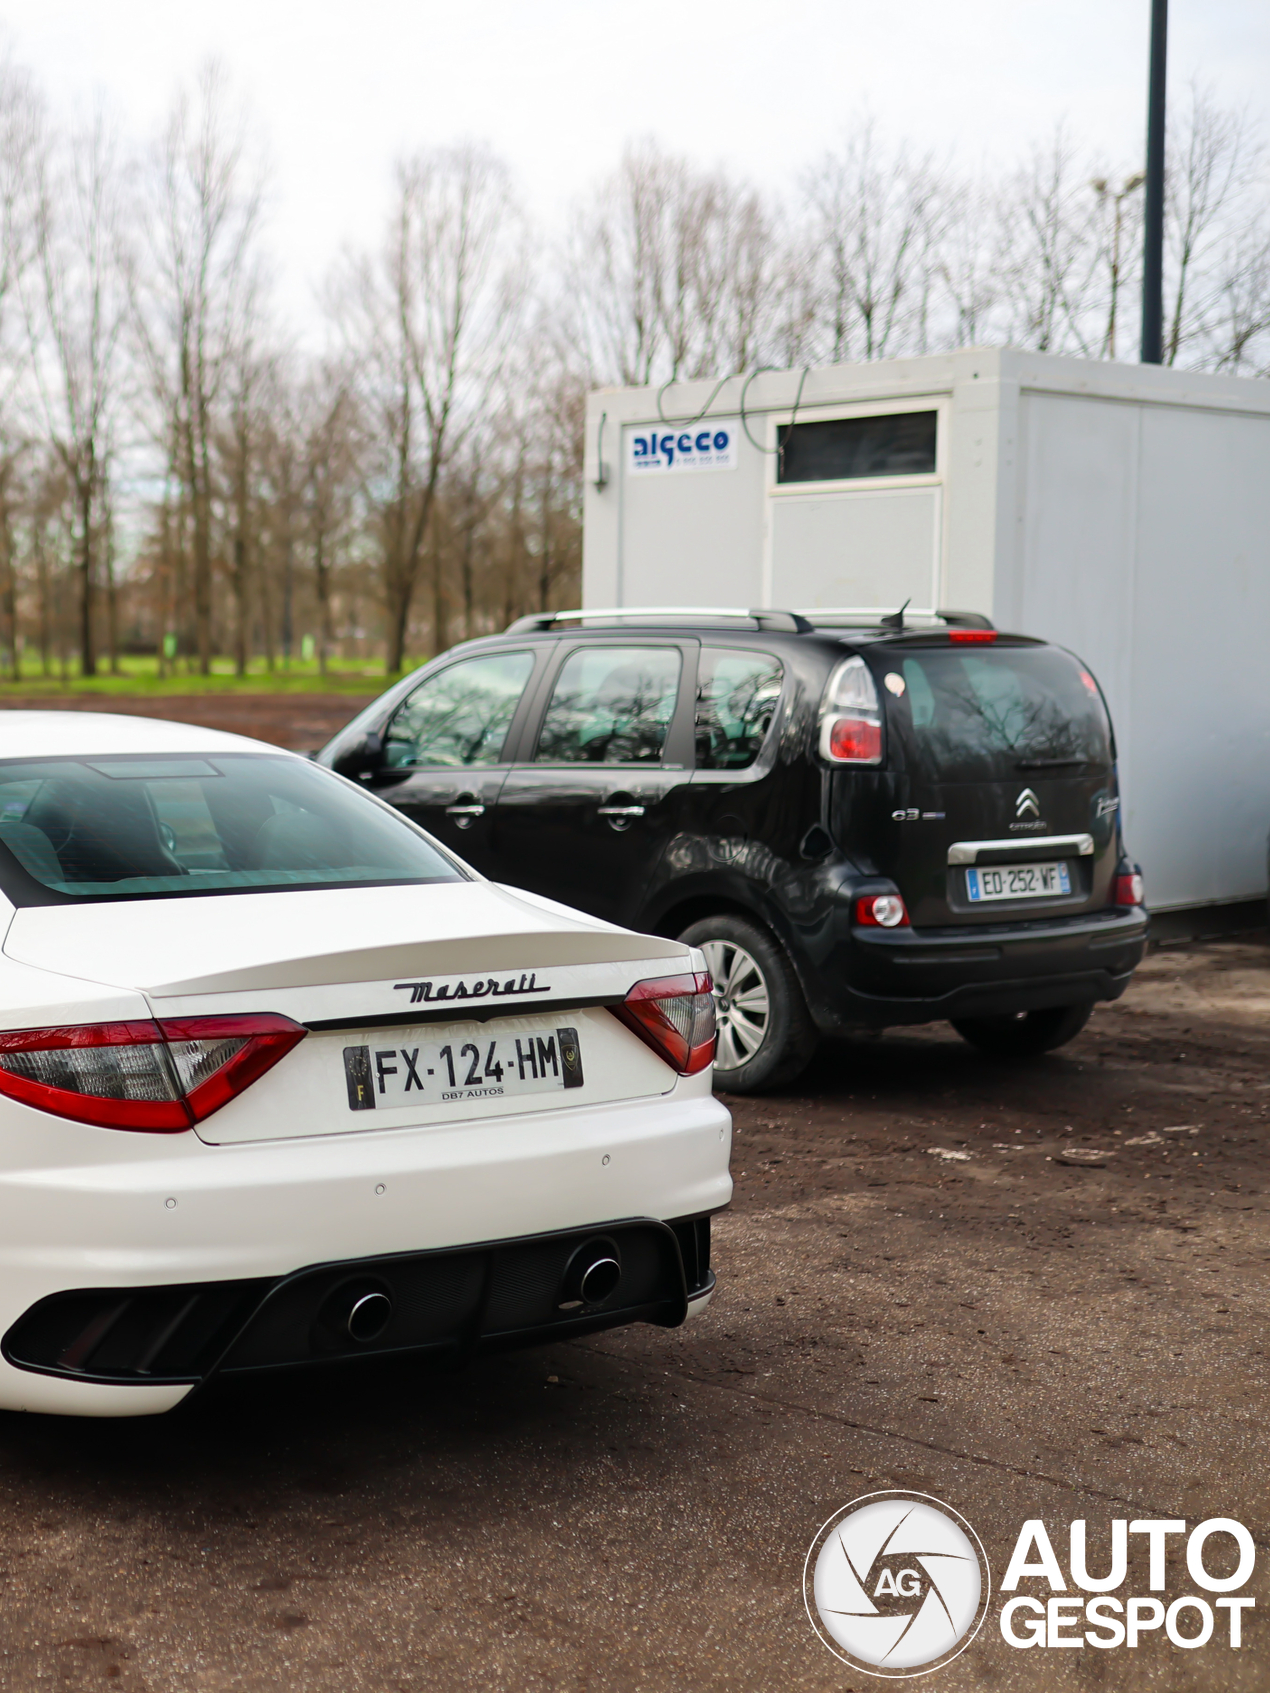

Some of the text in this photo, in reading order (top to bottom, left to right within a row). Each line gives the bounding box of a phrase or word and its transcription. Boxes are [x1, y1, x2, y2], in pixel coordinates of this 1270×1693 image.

[393, 973, 551, 1003] Maserati
[375, 1036, 559, 1094] FX-124-HM
[357, 1085, 364, 1101] F
[442, 1087, 504, 1100] DB7 AUTOS
